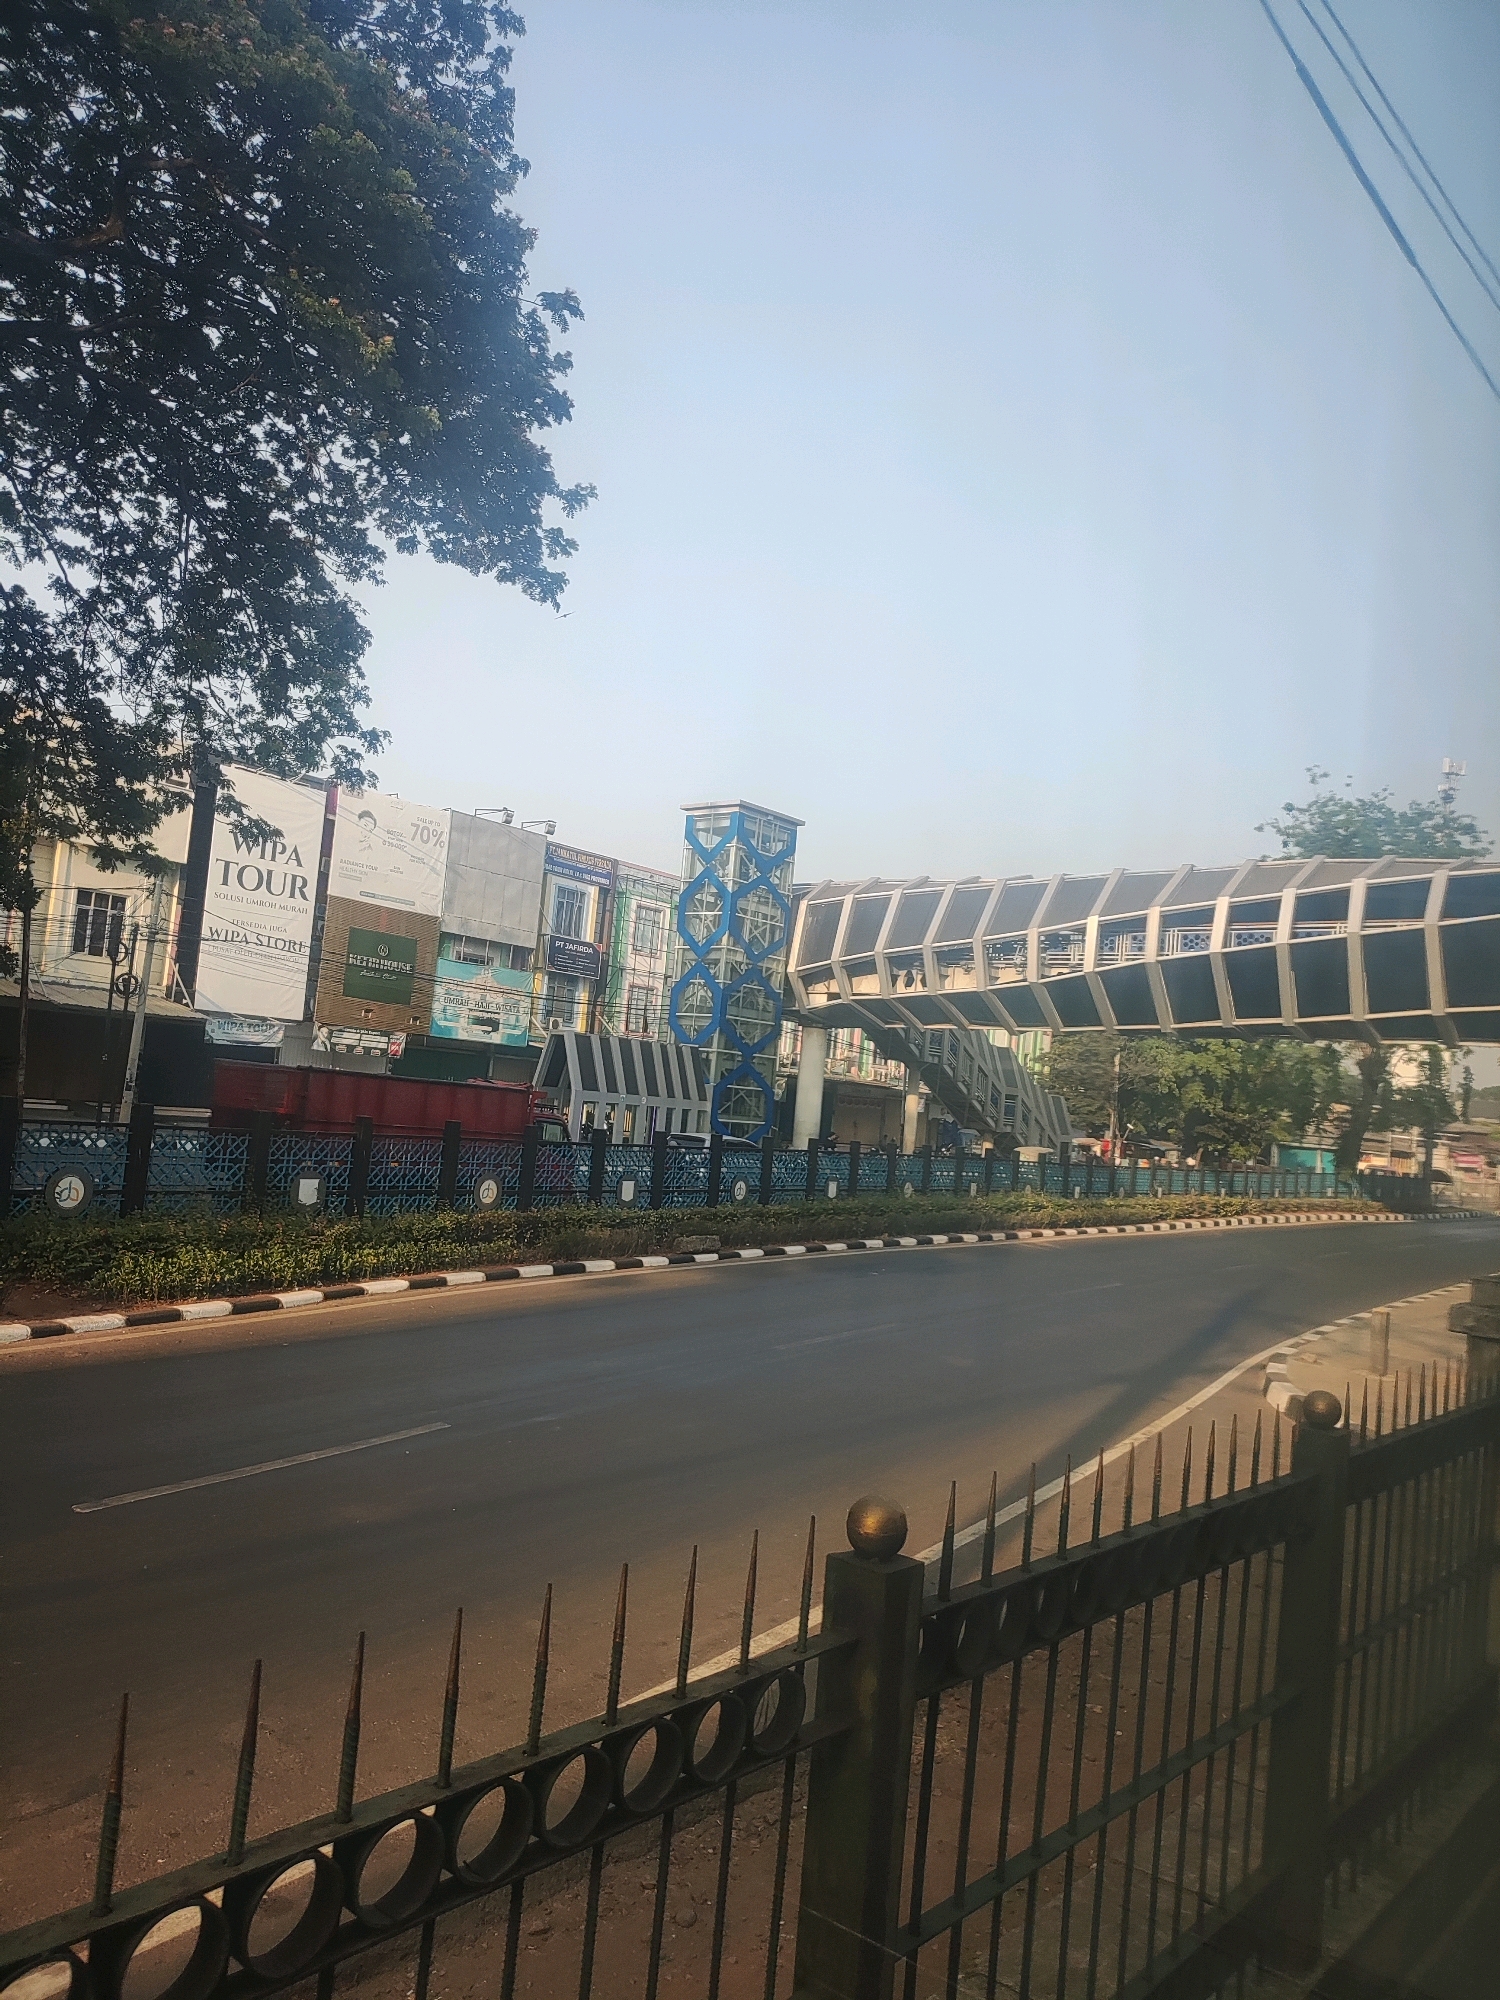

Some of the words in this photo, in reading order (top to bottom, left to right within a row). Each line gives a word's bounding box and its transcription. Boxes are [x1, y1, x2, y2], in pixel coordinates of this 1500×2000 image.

[416, 816, 428, 824] SALE
[410, 822, 446, 848] 70%
[231, 829, 305, 868] WIPA
[340, 858, 364, 868] RADIANCE
[365, 863, 378, 871] YOUR
[215, 858, 311, 902] TOUR
[214, 891, 244, 904] SOLUSI
[246, 897, 277, 910] UMROH
[279, 904, 308, 915] MURAH
[232, 918, 267, 931] TERSEDIA
[269, 925, 288, 934] JUGA
[208, 926, 250, 945] WIPA
[256, 934, 307, 954] STORE
[565, 942, 593, 954] JAFIRDA
[444, 996, 469, 1006] UMRAH
[474, 1001, 490, 1009] HAJI
[495, 1004, 520, 1013] WISATA
[217, 1020, 244, 1032] WIPA
[246, 1021, 276, 1034] TOUR
